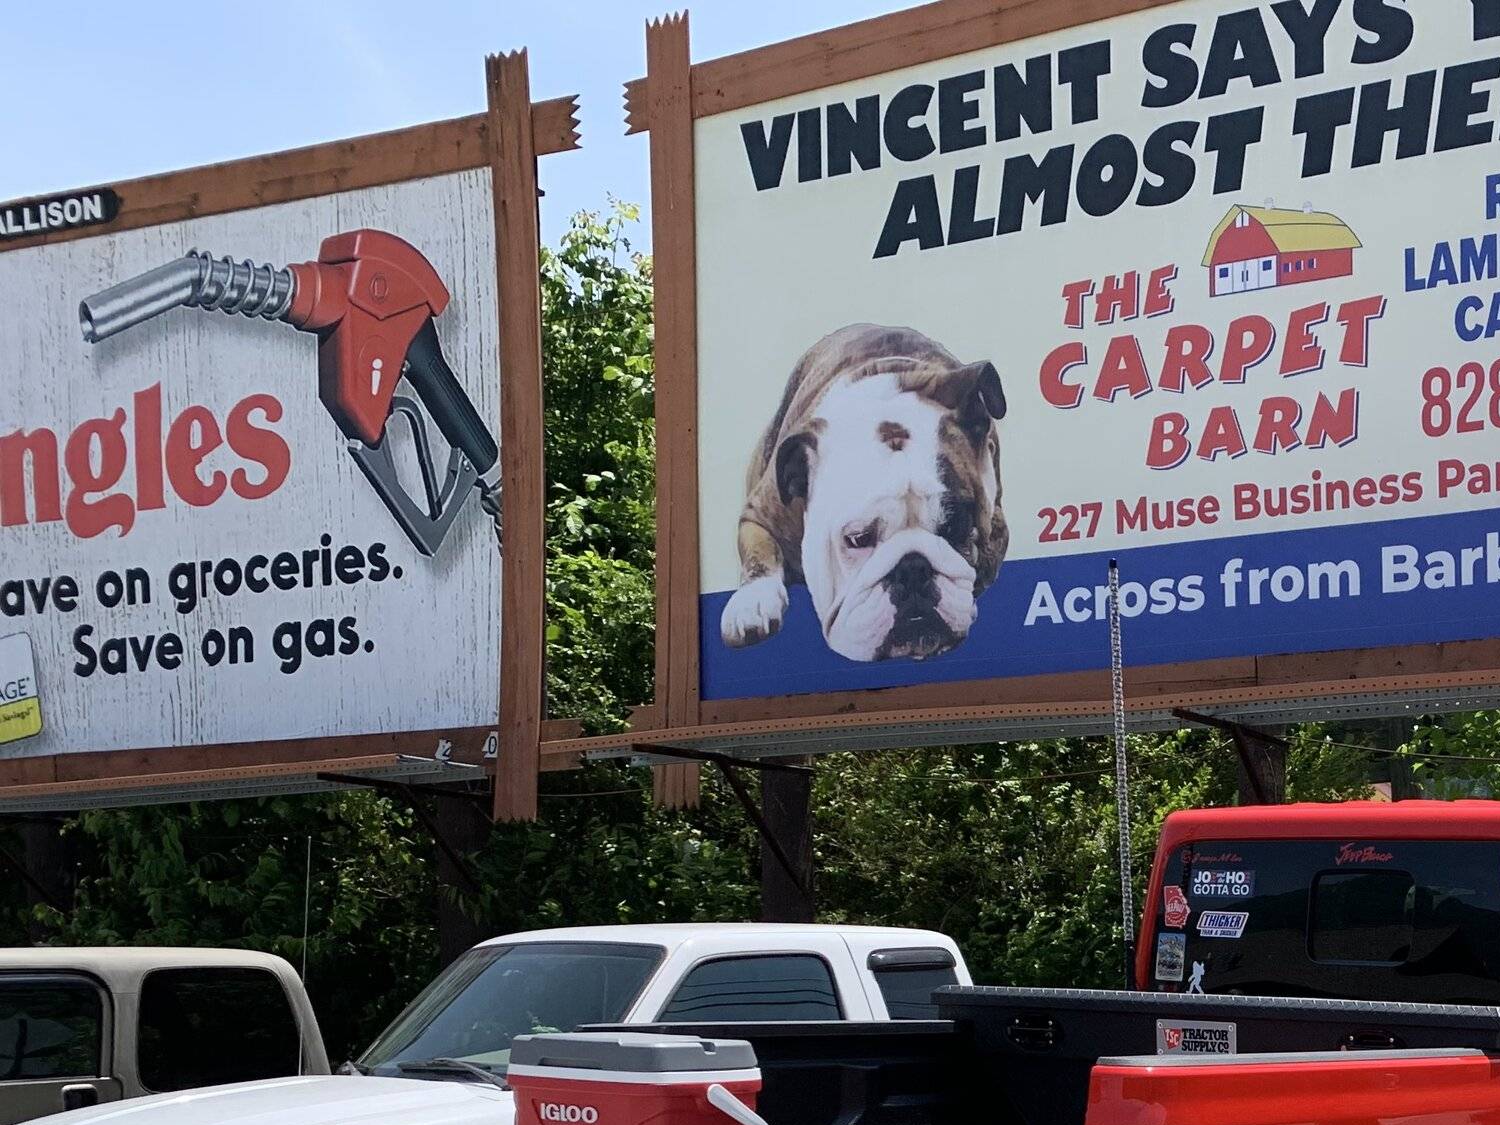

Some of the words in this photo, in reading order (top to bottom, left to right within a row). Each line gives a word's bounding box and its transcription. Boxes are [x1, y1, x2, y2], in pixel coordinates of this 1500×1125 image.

[740, 39, 1111, 192] VINCENT
[1142, 0, 1414, 107] SAYS
[873, 105, 1264, 259] ALMOST
[1062, 263, 1178, 329] THE
[1039, 295, 1387, 409] CARPET
[1145, 387, 1360, 470] BARN
[1037, 502, 1102, 543] 227
[1116, 495, 1220, 535] Muse
[1234, 469, 1424, 521] Business
[96, 568, 151, 608] on
[168, 534, 403, 613] groceries.
[1024, 574, 1206, 626] Across
[1220, 558, 1361, 607] from
[73, 625, 183, 677] Save
[201, 625, 254, 666] on
[272, 616, 375, 674] gas.
[1193, 884, 1229, 895] GOTTA
[1232, 885, 1249, 895] GO
[1203, 914, 1242, 928] THICKER
[1165, 1029, 1179, 1045] TSC
[1181, 1028, 1229, 1041] TRACTOR
[1181, 1040, 1217, 1052] SUPPLY
[540, 1102, 598, 1123] IGLOO
